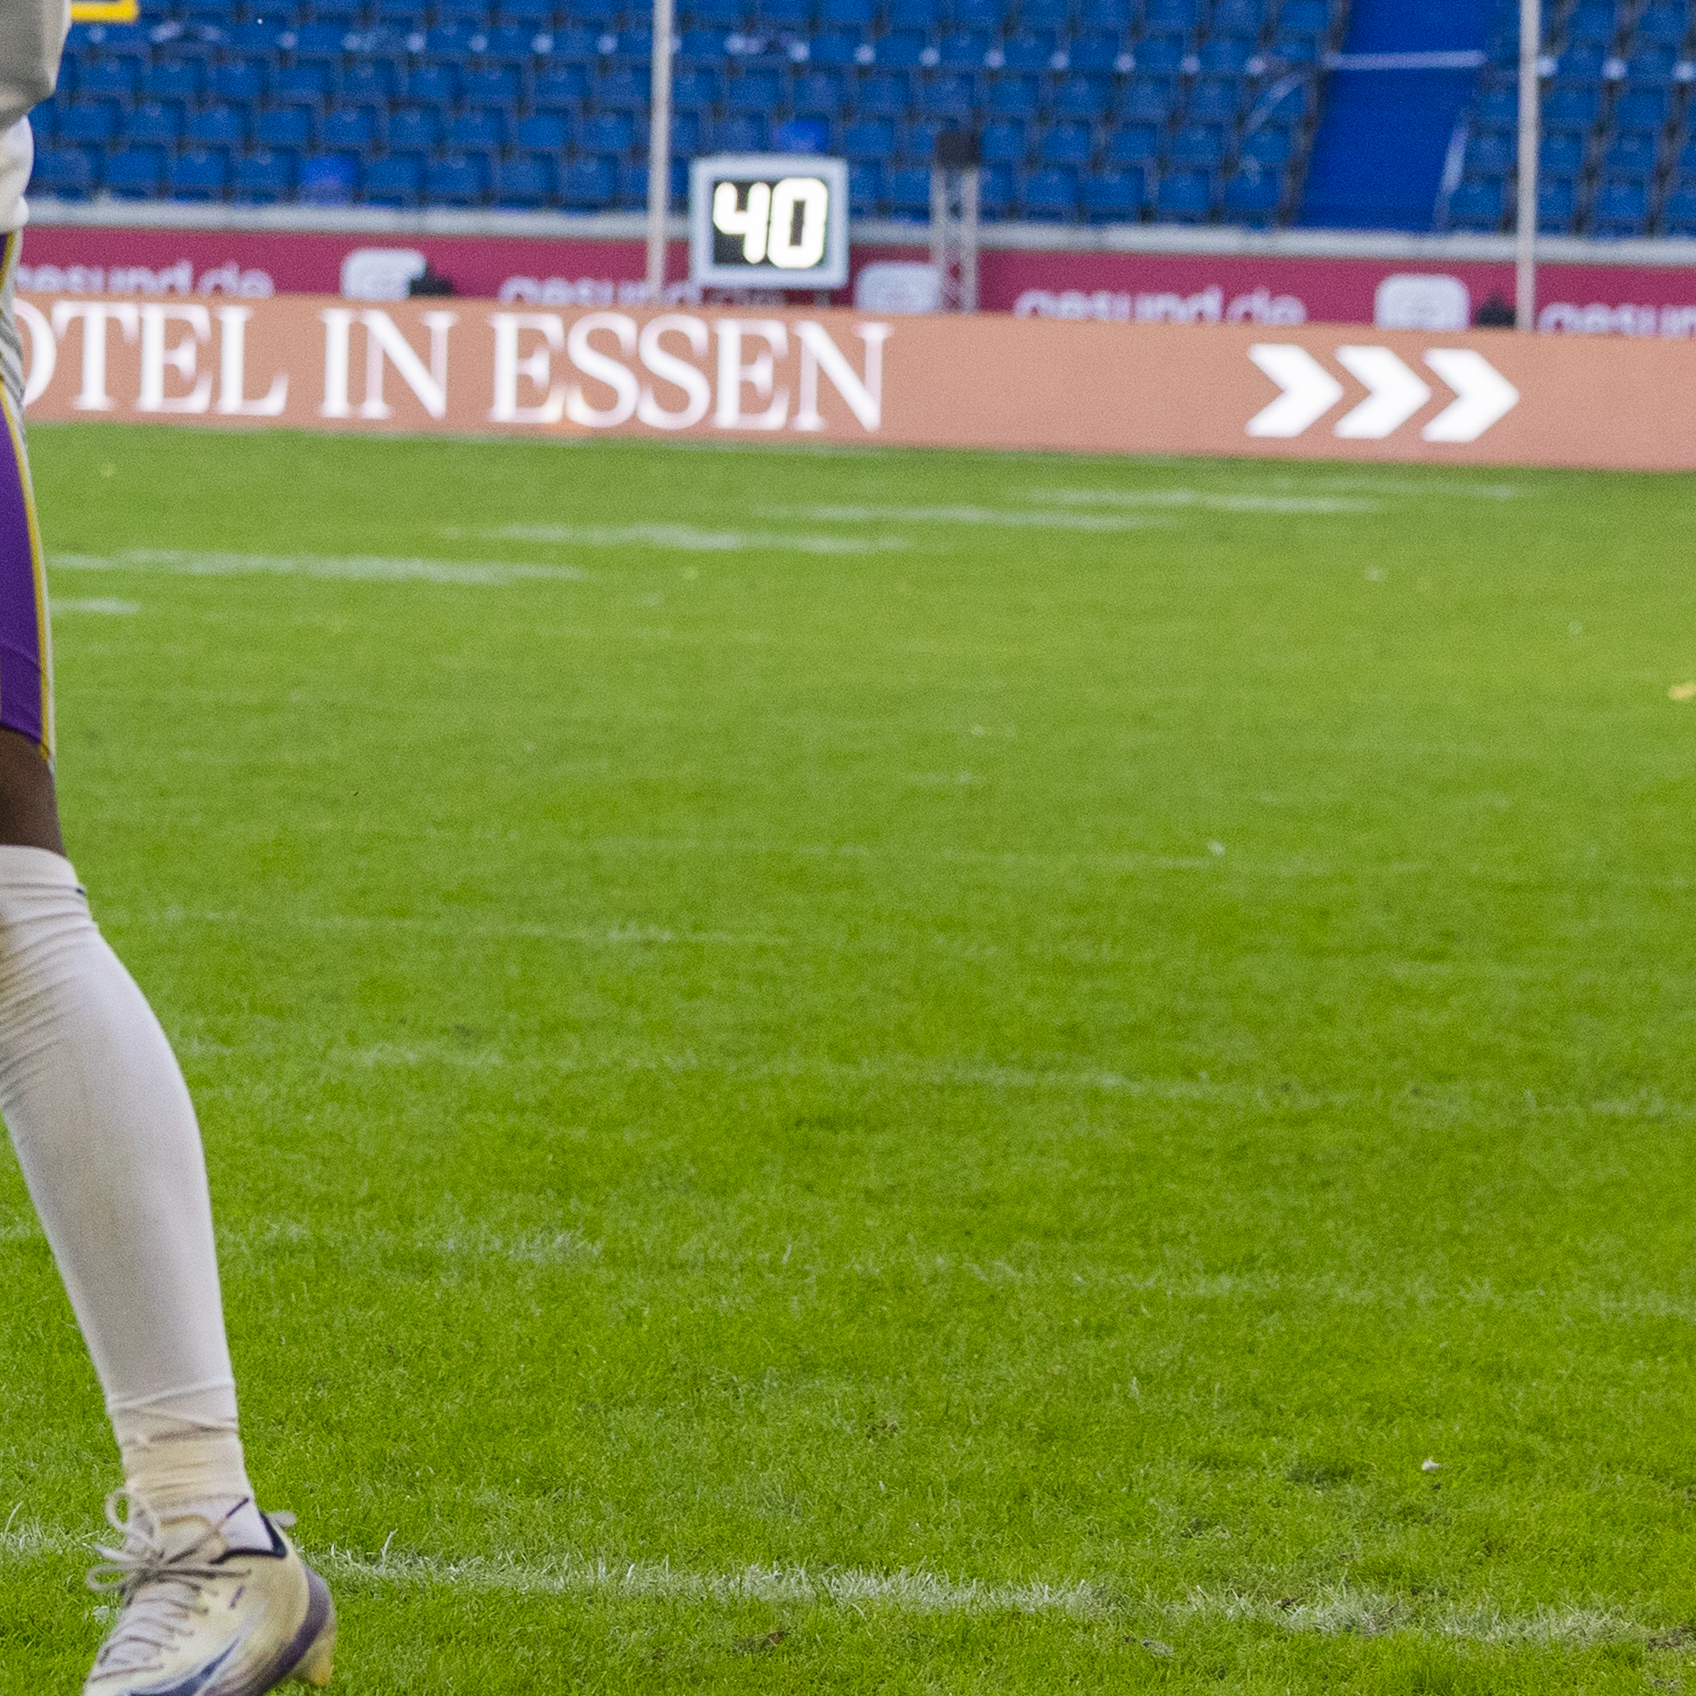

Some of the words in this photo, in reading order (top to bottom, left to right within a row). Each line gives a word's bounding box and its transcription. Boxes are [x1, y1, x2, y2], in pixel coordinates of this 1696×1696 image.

[713, 177, 828, 269] 40
[319, 307, 459, 420] IN
[487, 311, 894, 433] ESSEN
